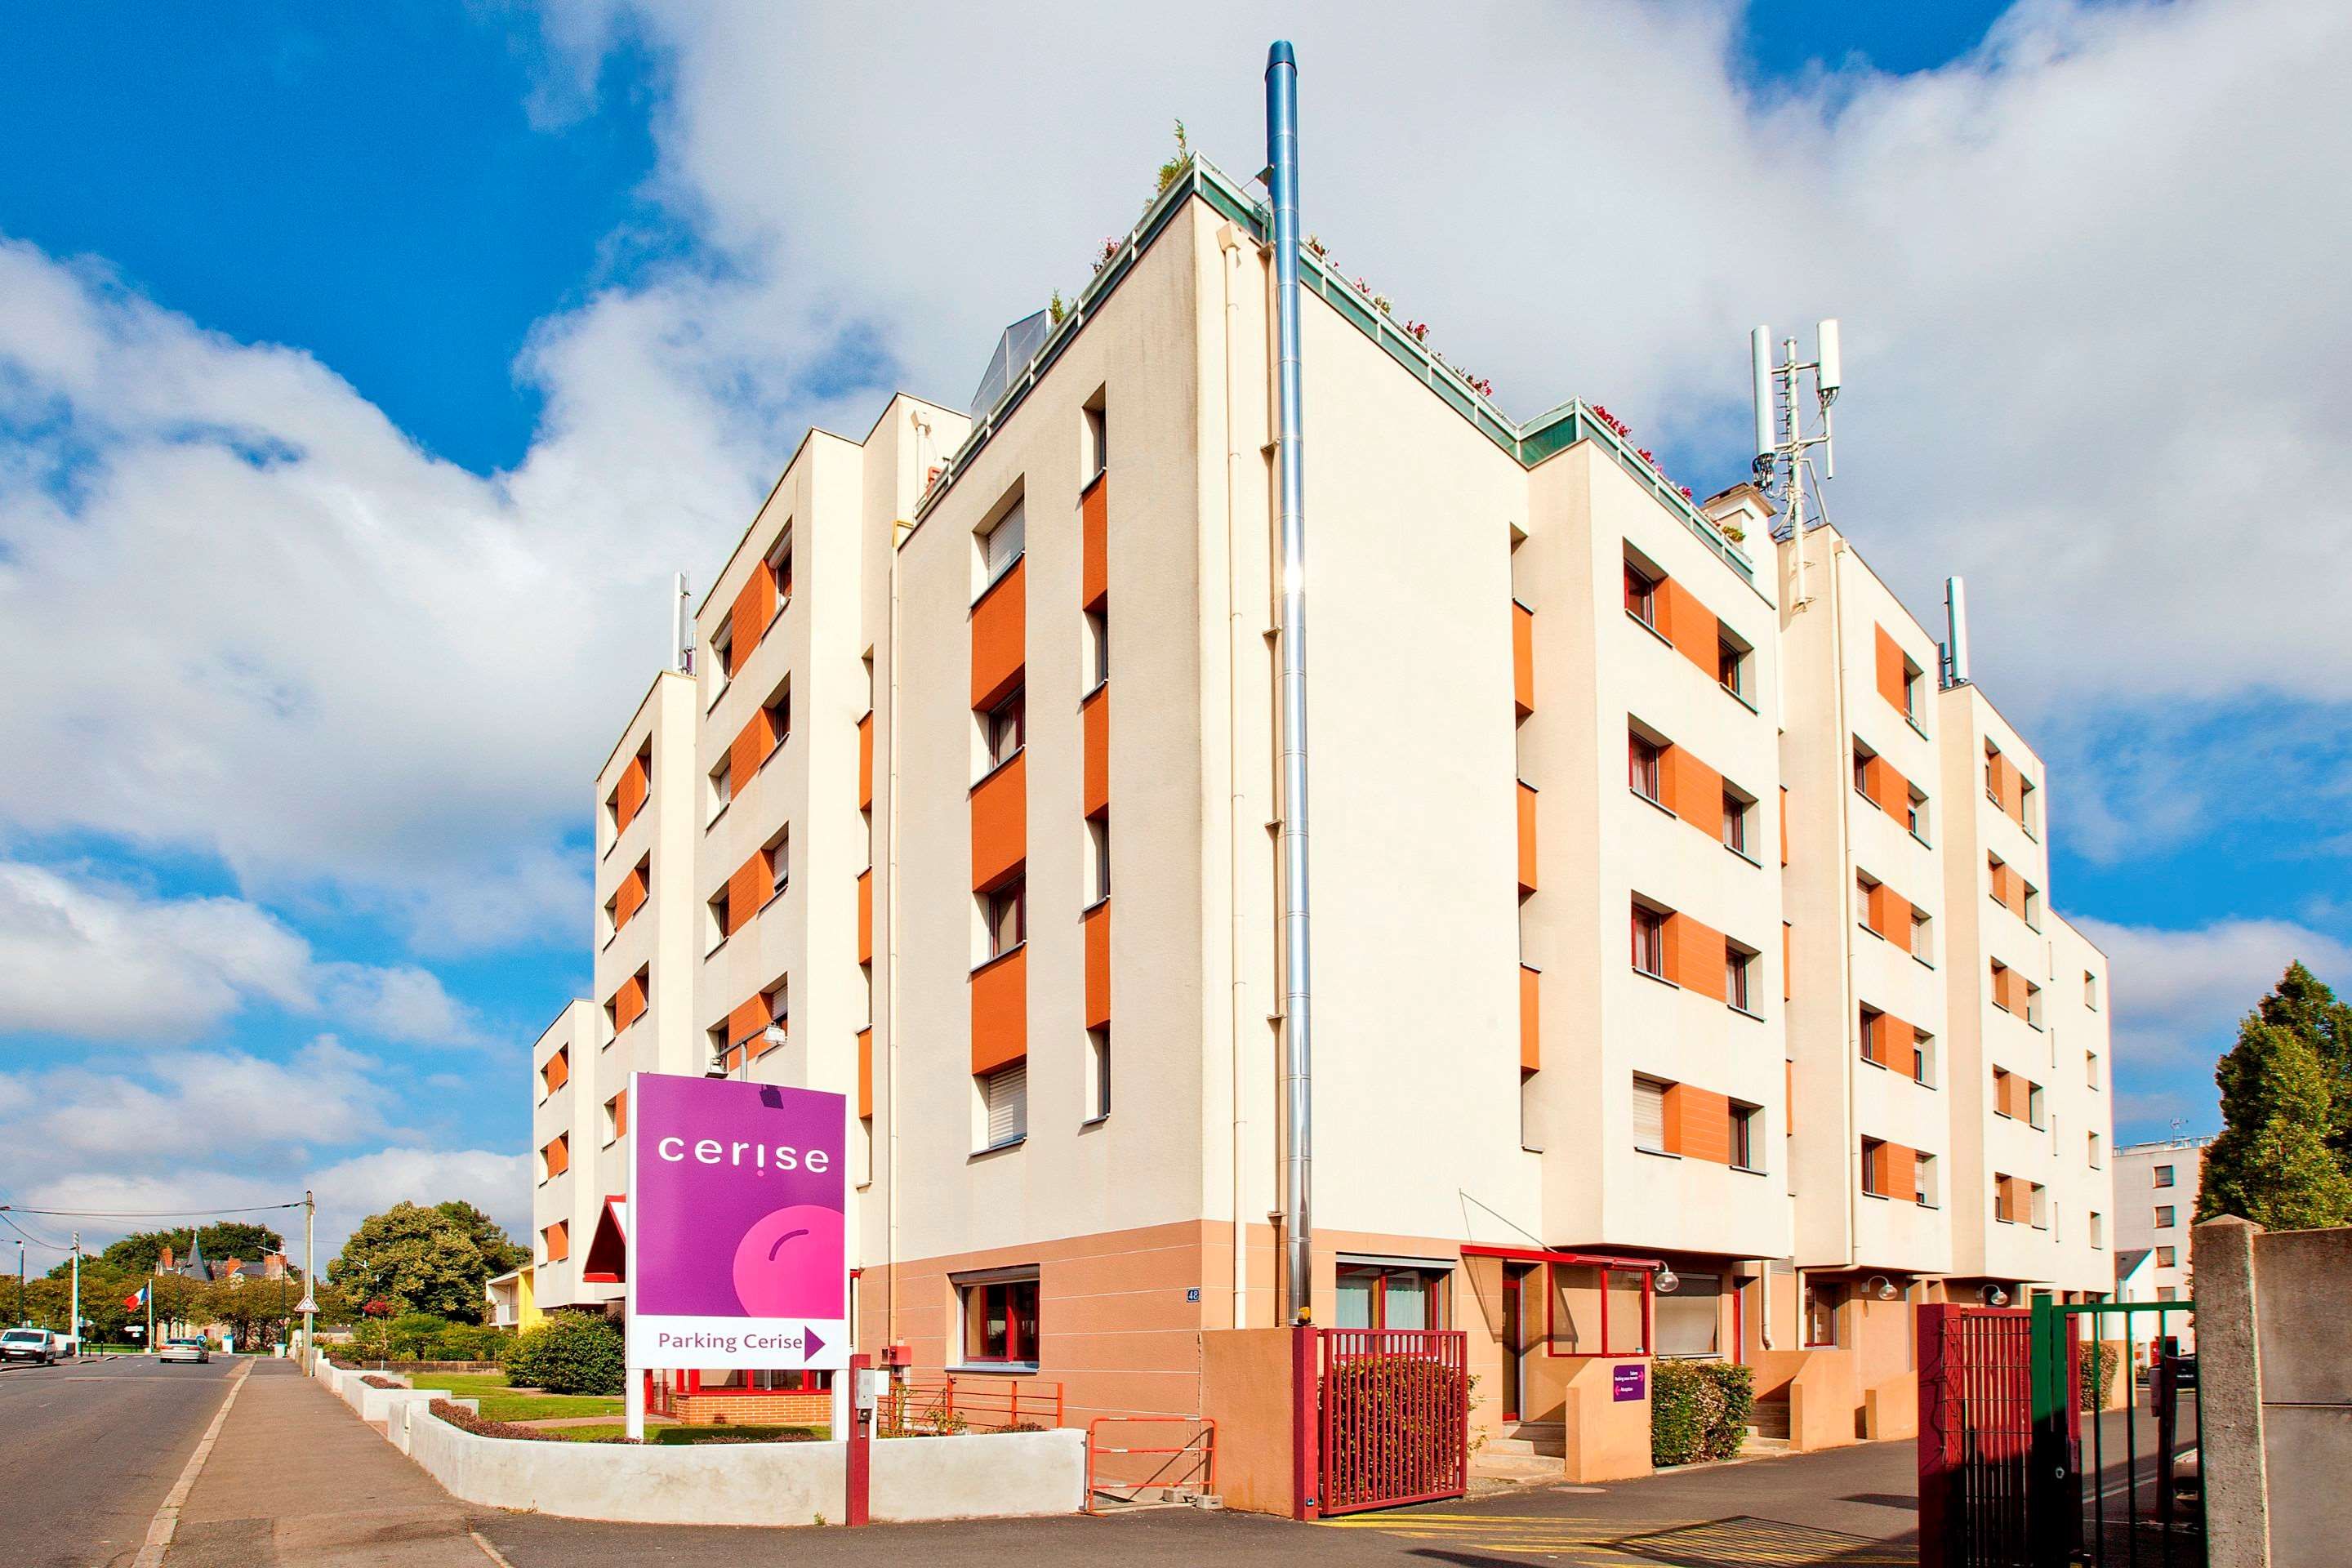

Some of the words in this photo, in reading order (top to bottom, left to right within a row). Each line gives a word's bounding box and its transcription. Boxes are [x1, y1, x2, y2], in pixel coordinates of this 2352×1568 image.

[657, 1136, 830, 1178] cerise
[658, 1332, 737, 1353] Parking
[743, 1334, 803, 1348] Cerise
